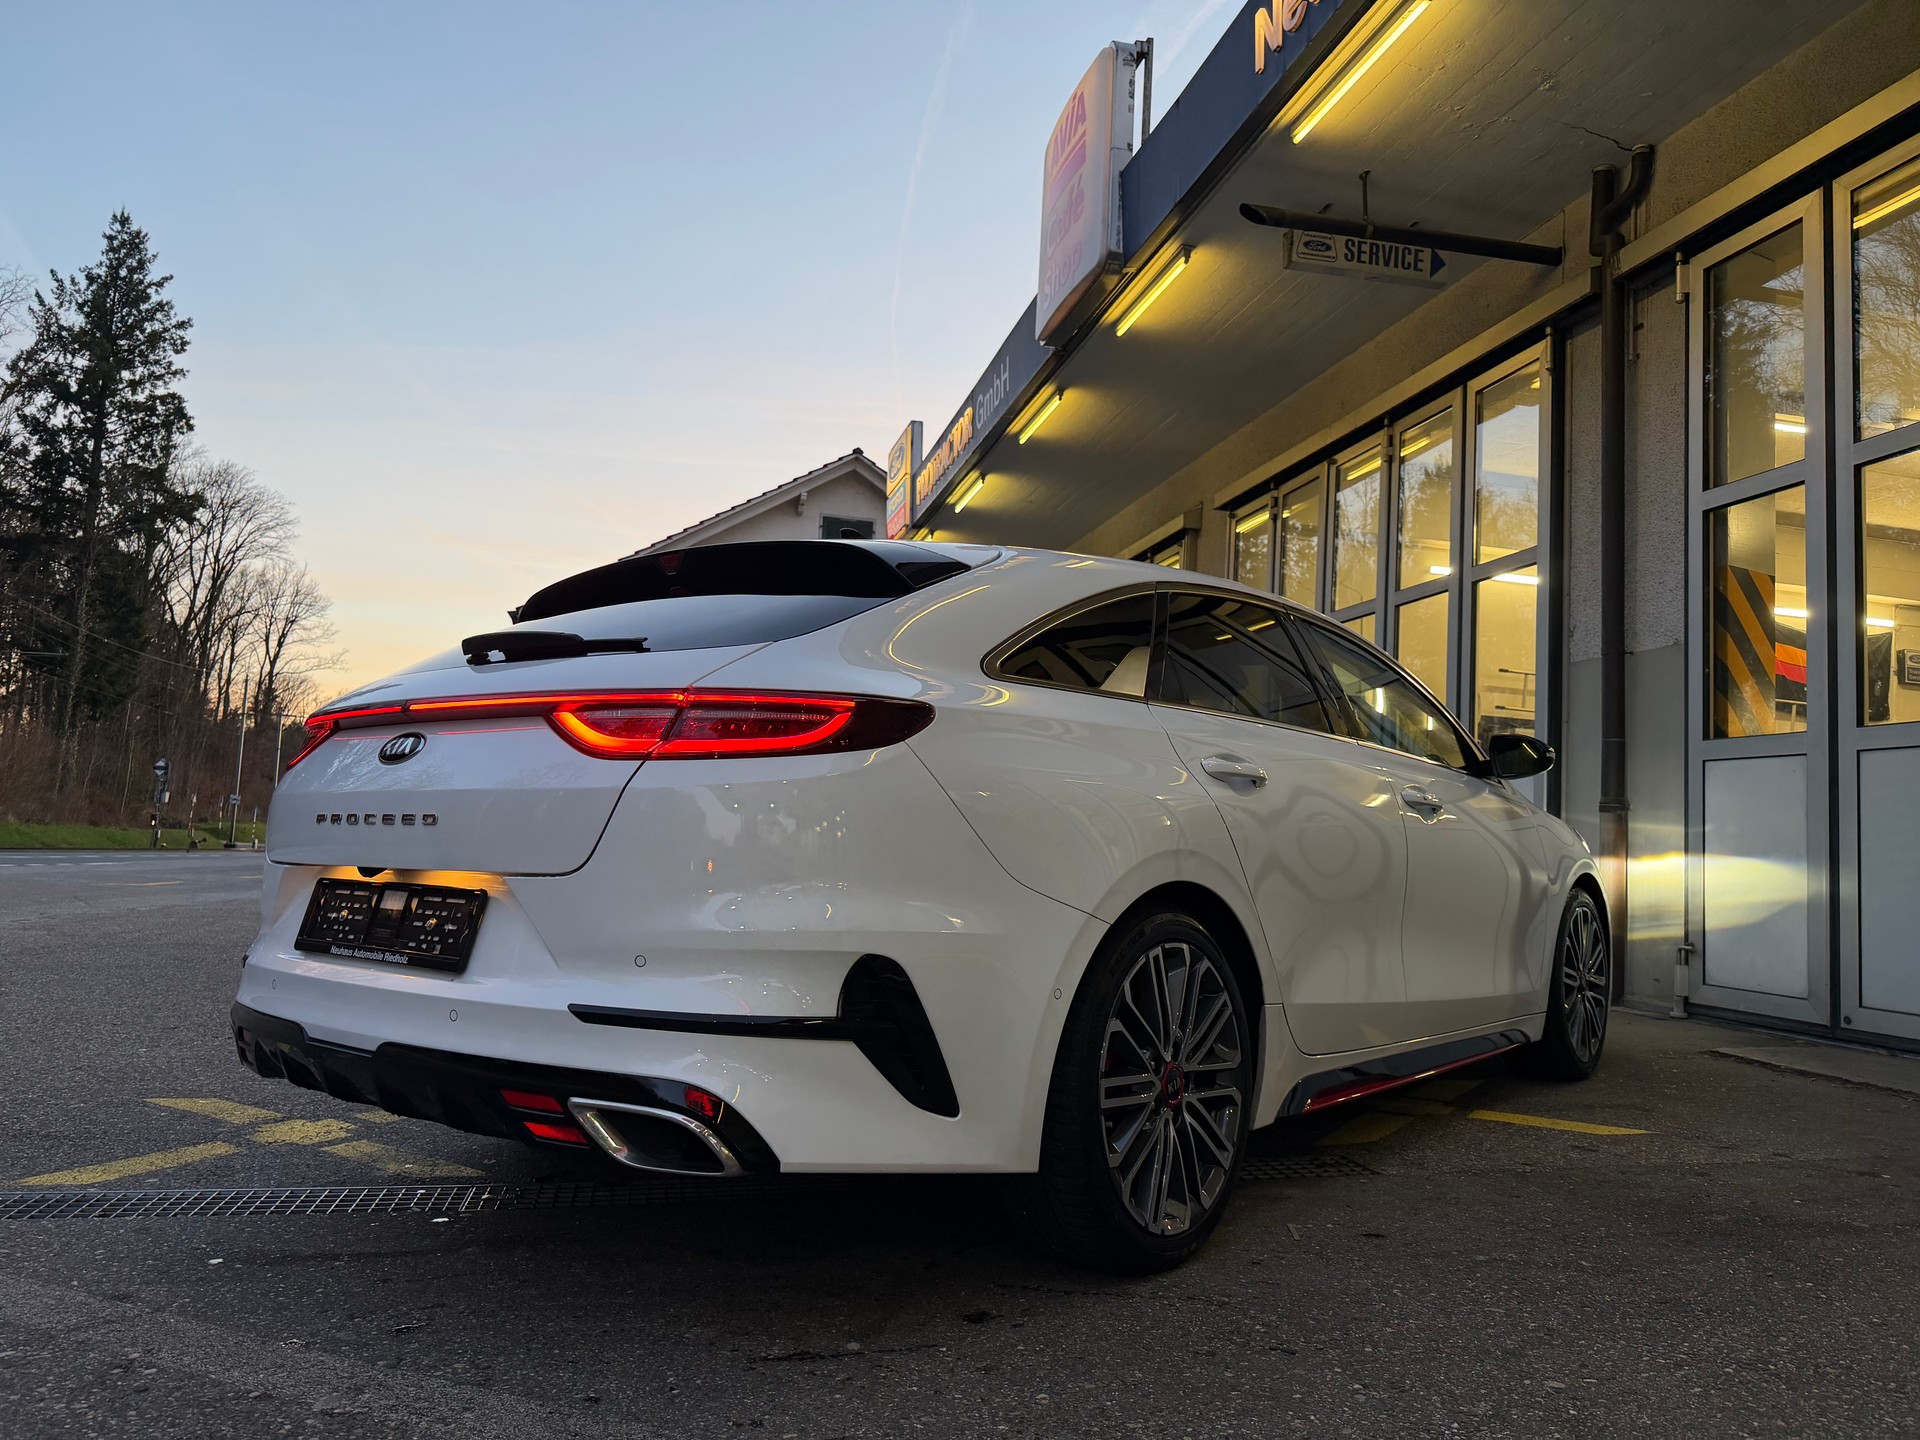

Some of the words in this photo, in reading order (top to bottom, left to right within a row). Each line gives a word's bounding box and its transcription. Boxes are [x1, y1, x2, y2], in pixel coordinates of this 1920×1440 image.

[1254, 0, 1321, 75] Ne
[1344, 238, 1425, 273] SERVICE
[975, 356, 1010, 430] GmbH
[381, 736, 415, 756] KIA
[316, 813, 439, 826] PROCEED
[330, 944, 353, 957] Neuhaus
[353, 948, 384, 961] Automobile
[383, 952, 409, 964] Riedholz
[1167, 1076, 1182, 1095] KIA
